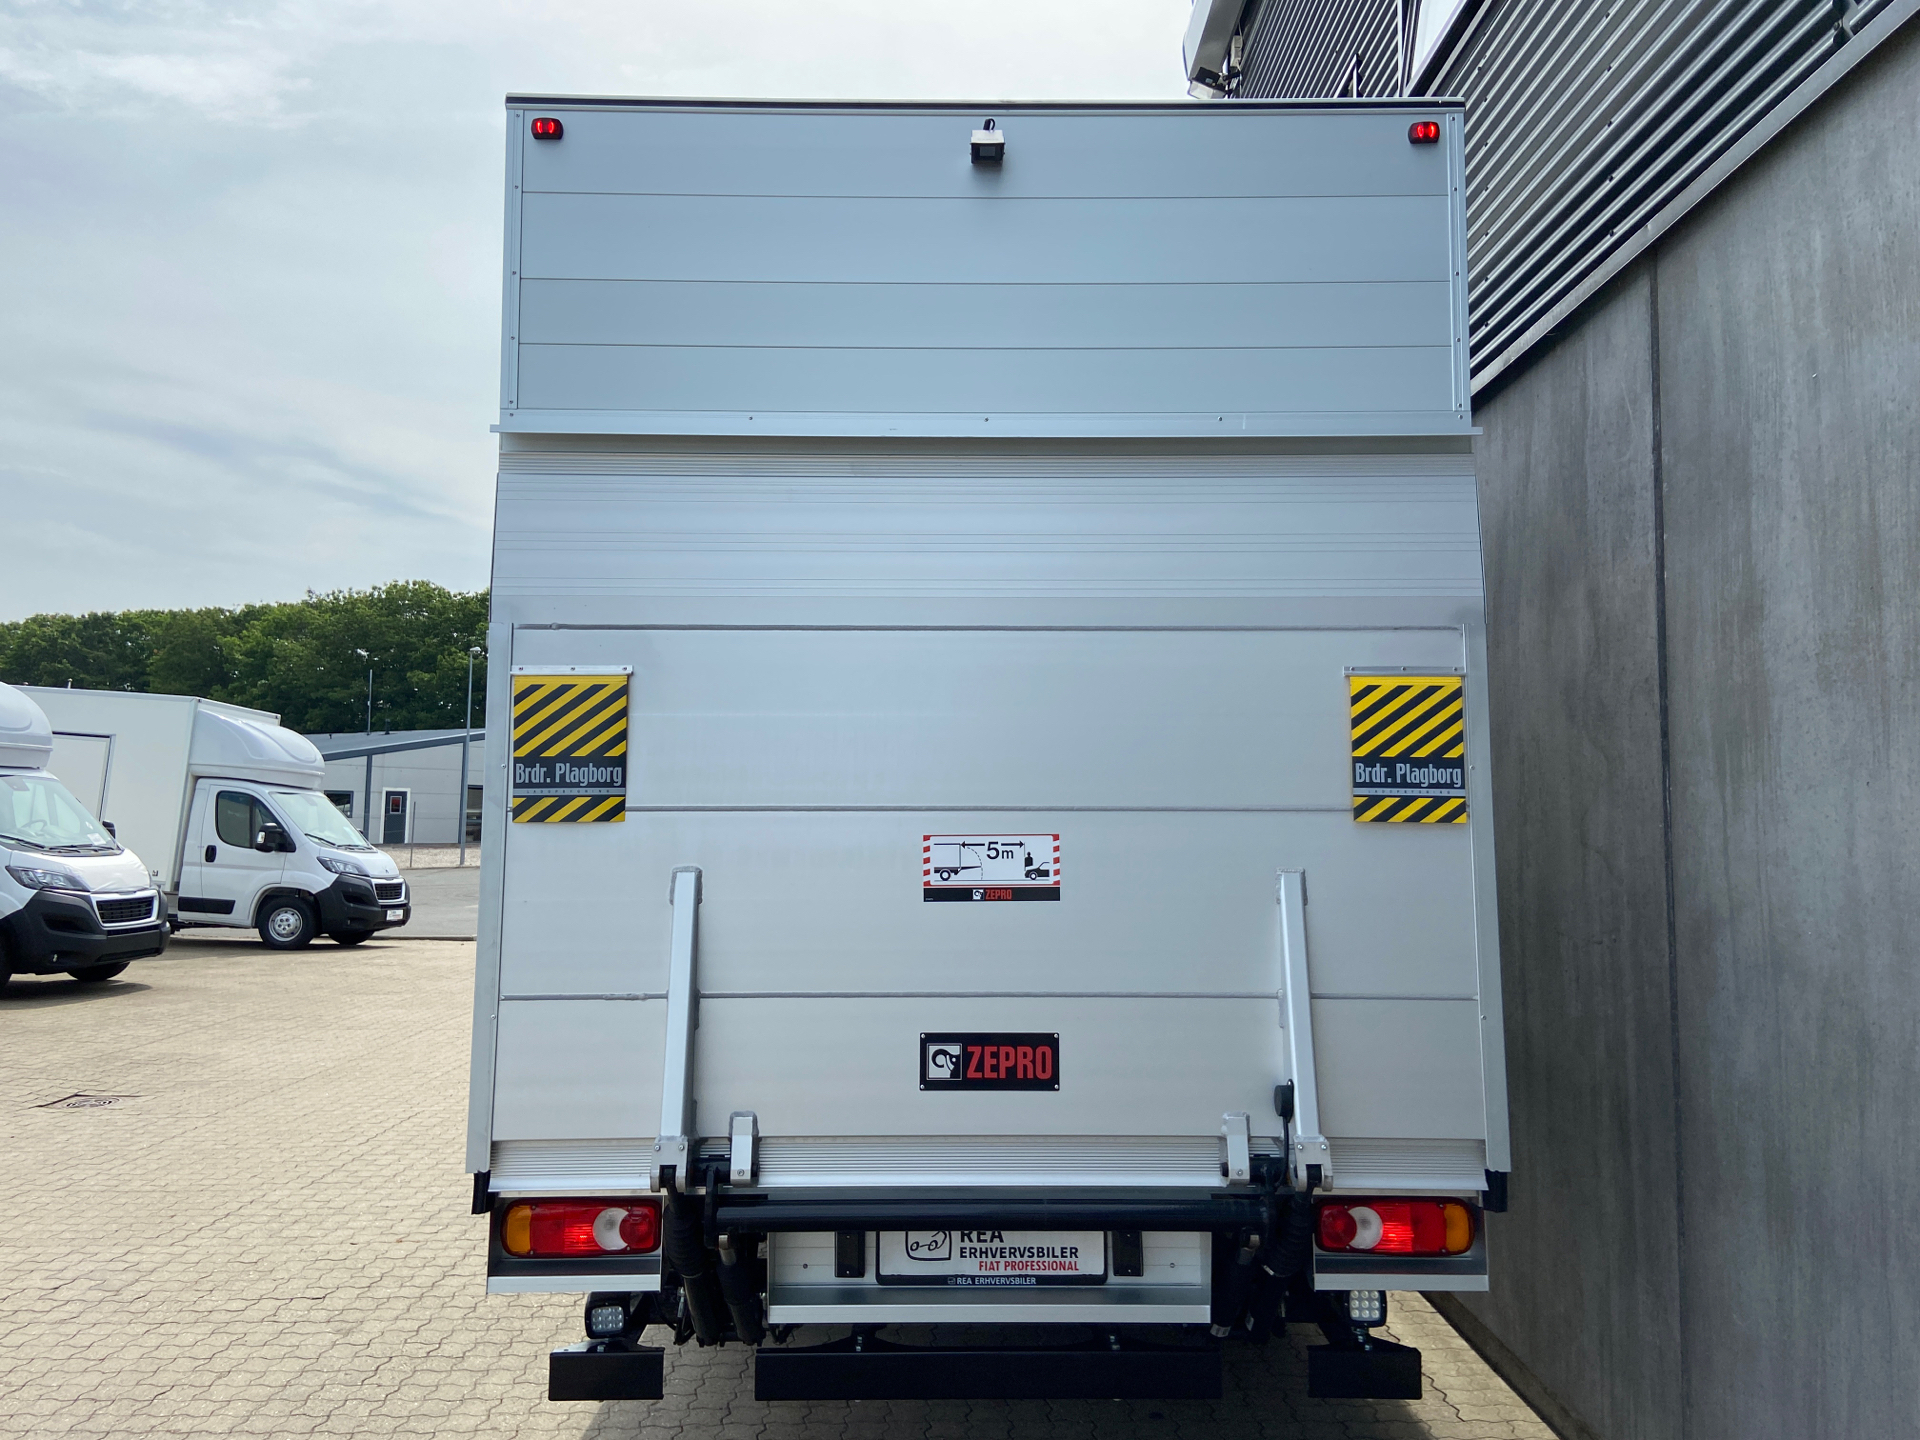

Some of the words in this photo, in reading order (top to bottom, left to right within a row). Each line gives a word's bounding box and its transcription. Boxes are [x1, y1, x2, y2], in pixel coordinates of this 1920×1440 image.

[515, 763, 551, 783] Brdr.
[555, 762, 622, 787] Plagborg
[1355, 762, 1392, 783] Brdr.
[1395, 763, 1462, 787] Plagborg
[985, 889, 1012, 900] ZEPRO
[966, 1045, 1053, 1080] ZEPRO
[960, 1230, 1004, 1243] REA
[960, 1246, 1079, 1259] ERHVERVSBILER
[979, 1260, 1001, 1272] FIAT
[1004, 1260, 1080, 1272] PROFESSIONAL
[957, 1277, 972, 1285] REA
[974, 1277, 1037, 1285] ERHVERVSBILER
